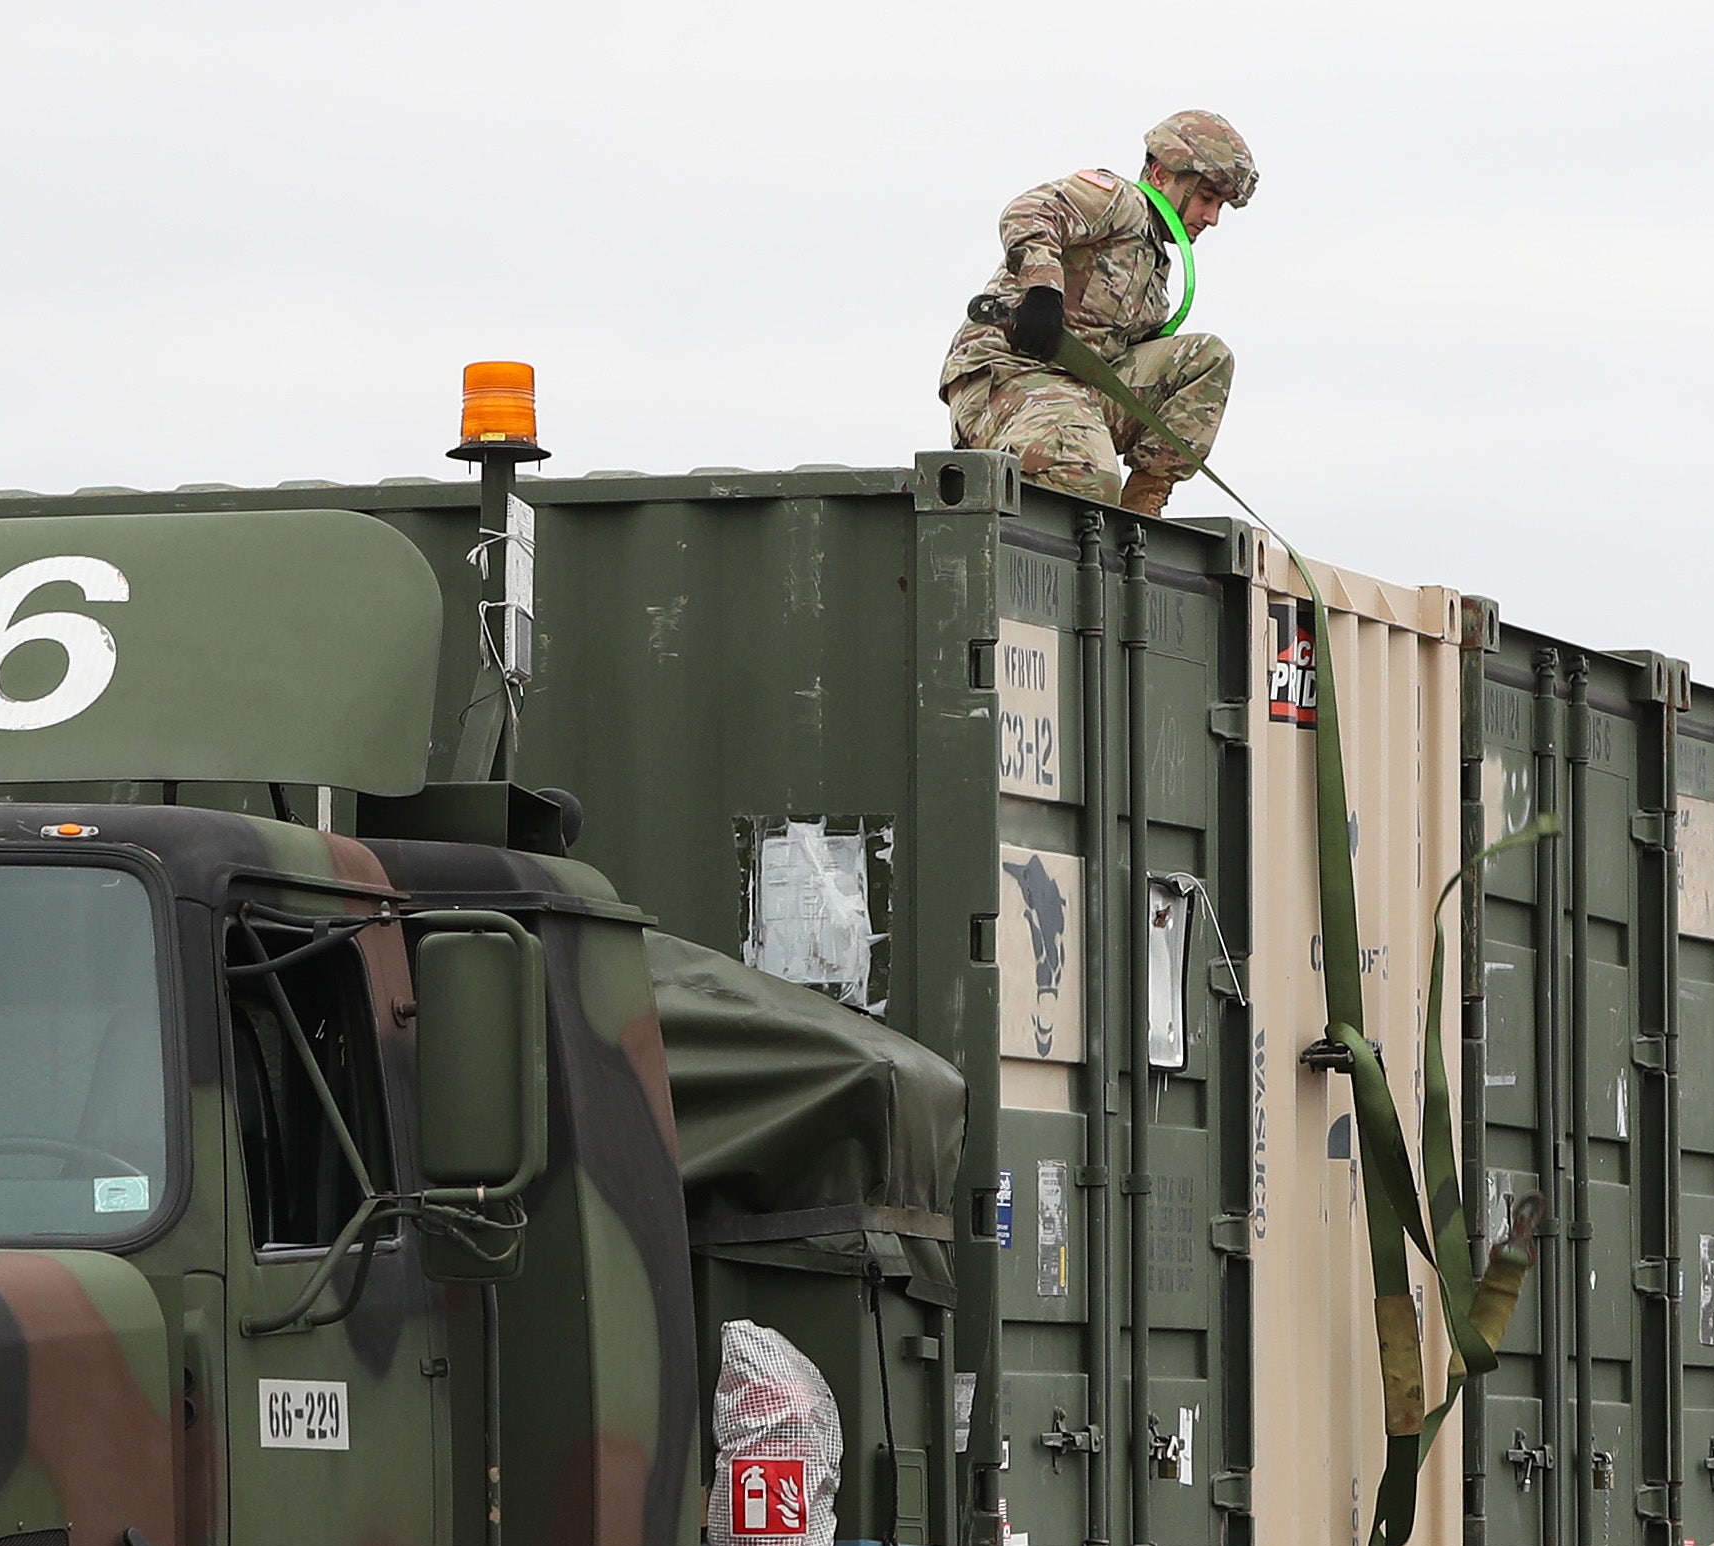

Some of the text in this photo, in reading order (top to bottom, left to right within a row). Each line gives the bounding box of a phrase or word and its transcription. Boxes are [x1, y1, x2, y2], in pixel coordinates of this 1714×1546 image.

[1042, 564, 1059, 618] 124
[999, 711, 1053, 787] C3-12
[269, 1391, 340, 1439] 66-229
